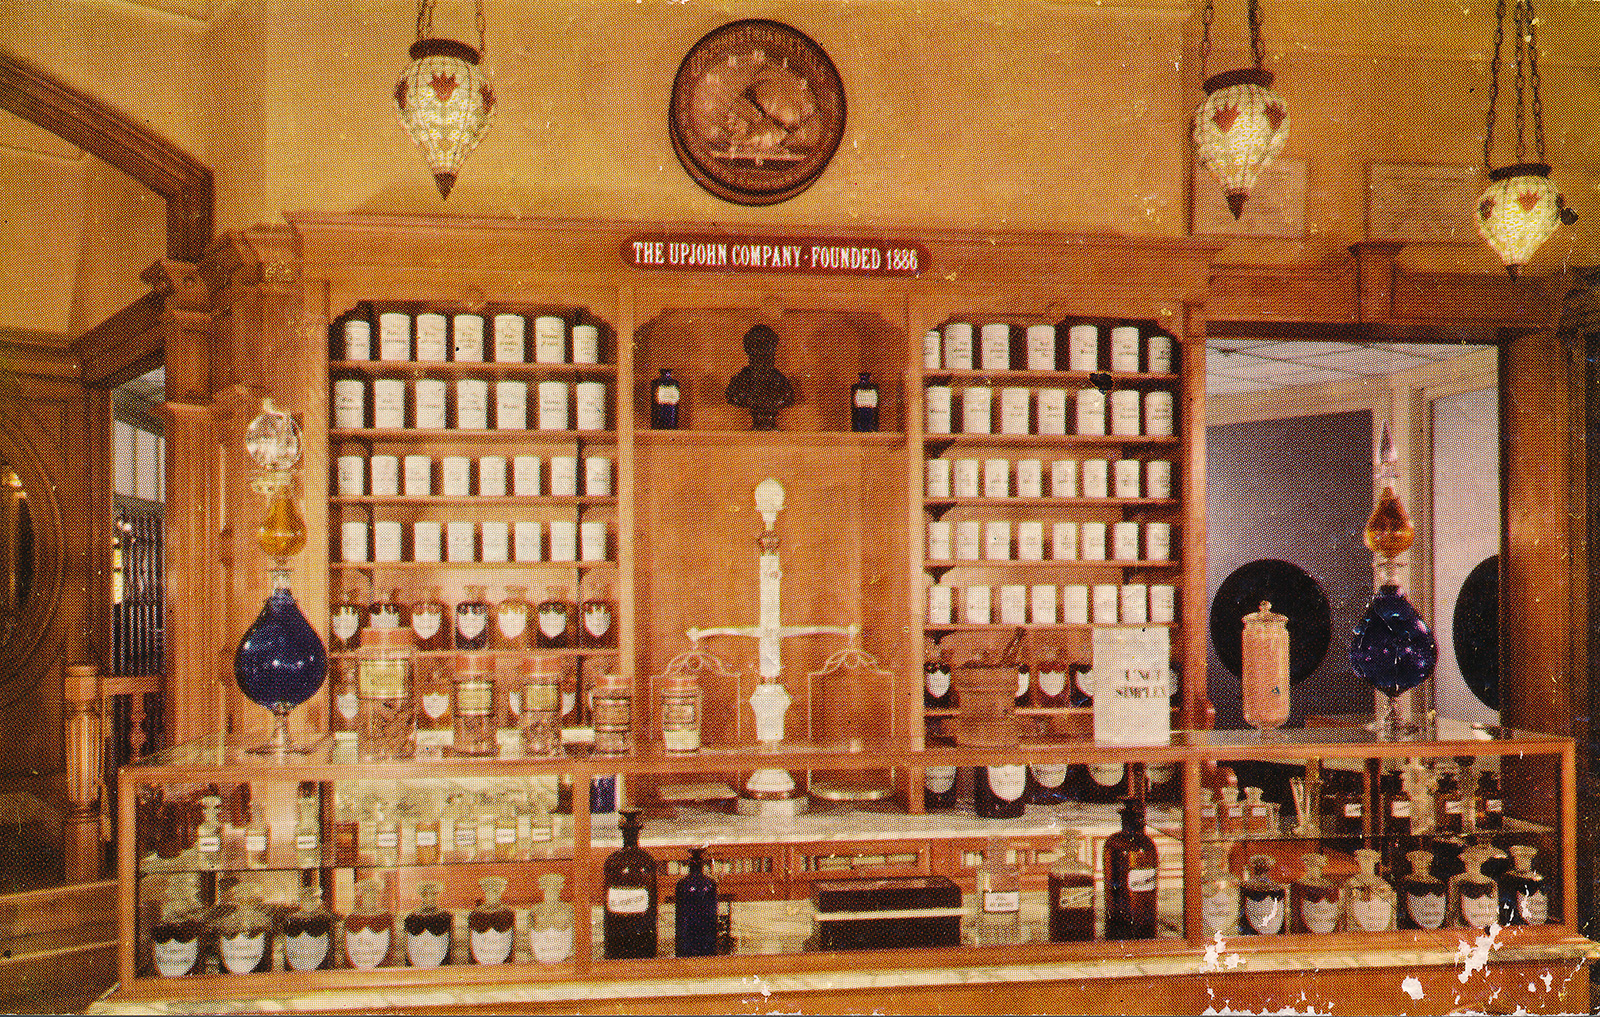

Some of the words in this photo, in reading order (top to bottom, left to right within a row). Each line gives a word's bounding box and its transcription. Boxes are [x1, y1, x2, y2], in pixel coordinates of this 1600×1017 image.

[632, 241, 665, 264] THE
[669, 243, 727, 266] UPJOHN
[732, 245, 802, 268] COMPANY
[811, 246, 881, 270] FOUNDED
[886, 249, 918, 271] 1886
[1123, 668, 1161, 682] UNT
